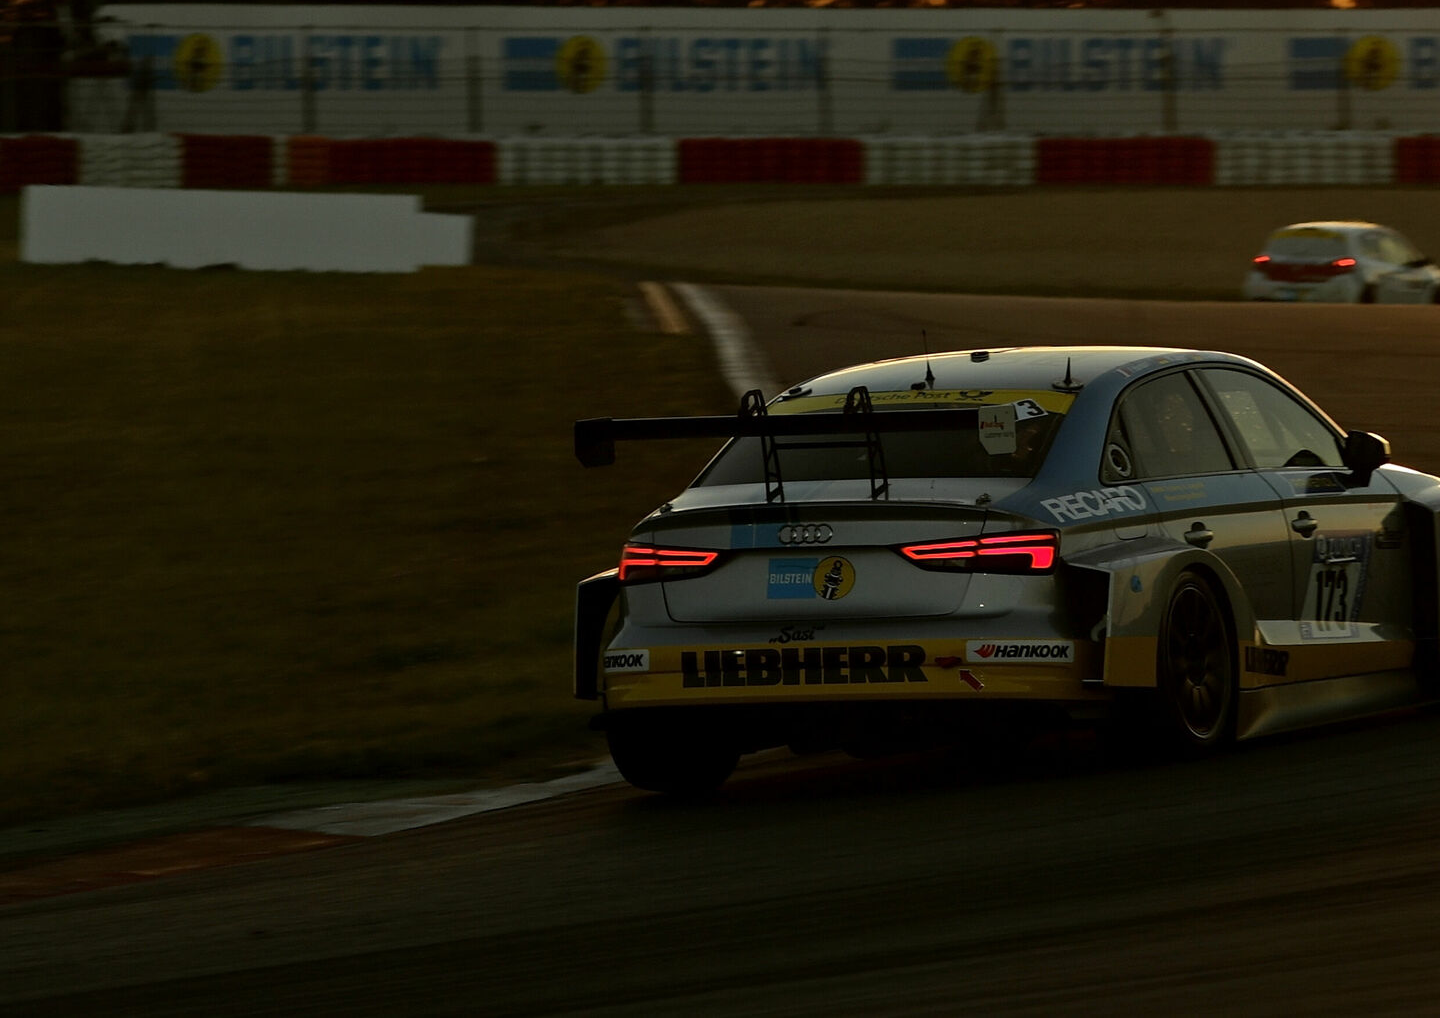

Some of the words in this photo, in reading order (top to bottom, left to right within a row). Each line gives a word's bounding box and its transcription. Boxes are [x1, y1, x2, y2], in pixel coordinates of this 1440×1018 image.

[232, 35, 440, 90] BILSTEIN
[617, 38, 830, 91] BILSTEIN
[1008, 38, 1226, 91] BILSTEIN
[914, 390, 951, 400] Post
[1040, 485, 1147, 523] RECARO
[769, 573, 812, 585] BILSTEIN
[1315, 569, 1347, 621] 173
[681, 645, 928, 688] LIEBHERR
